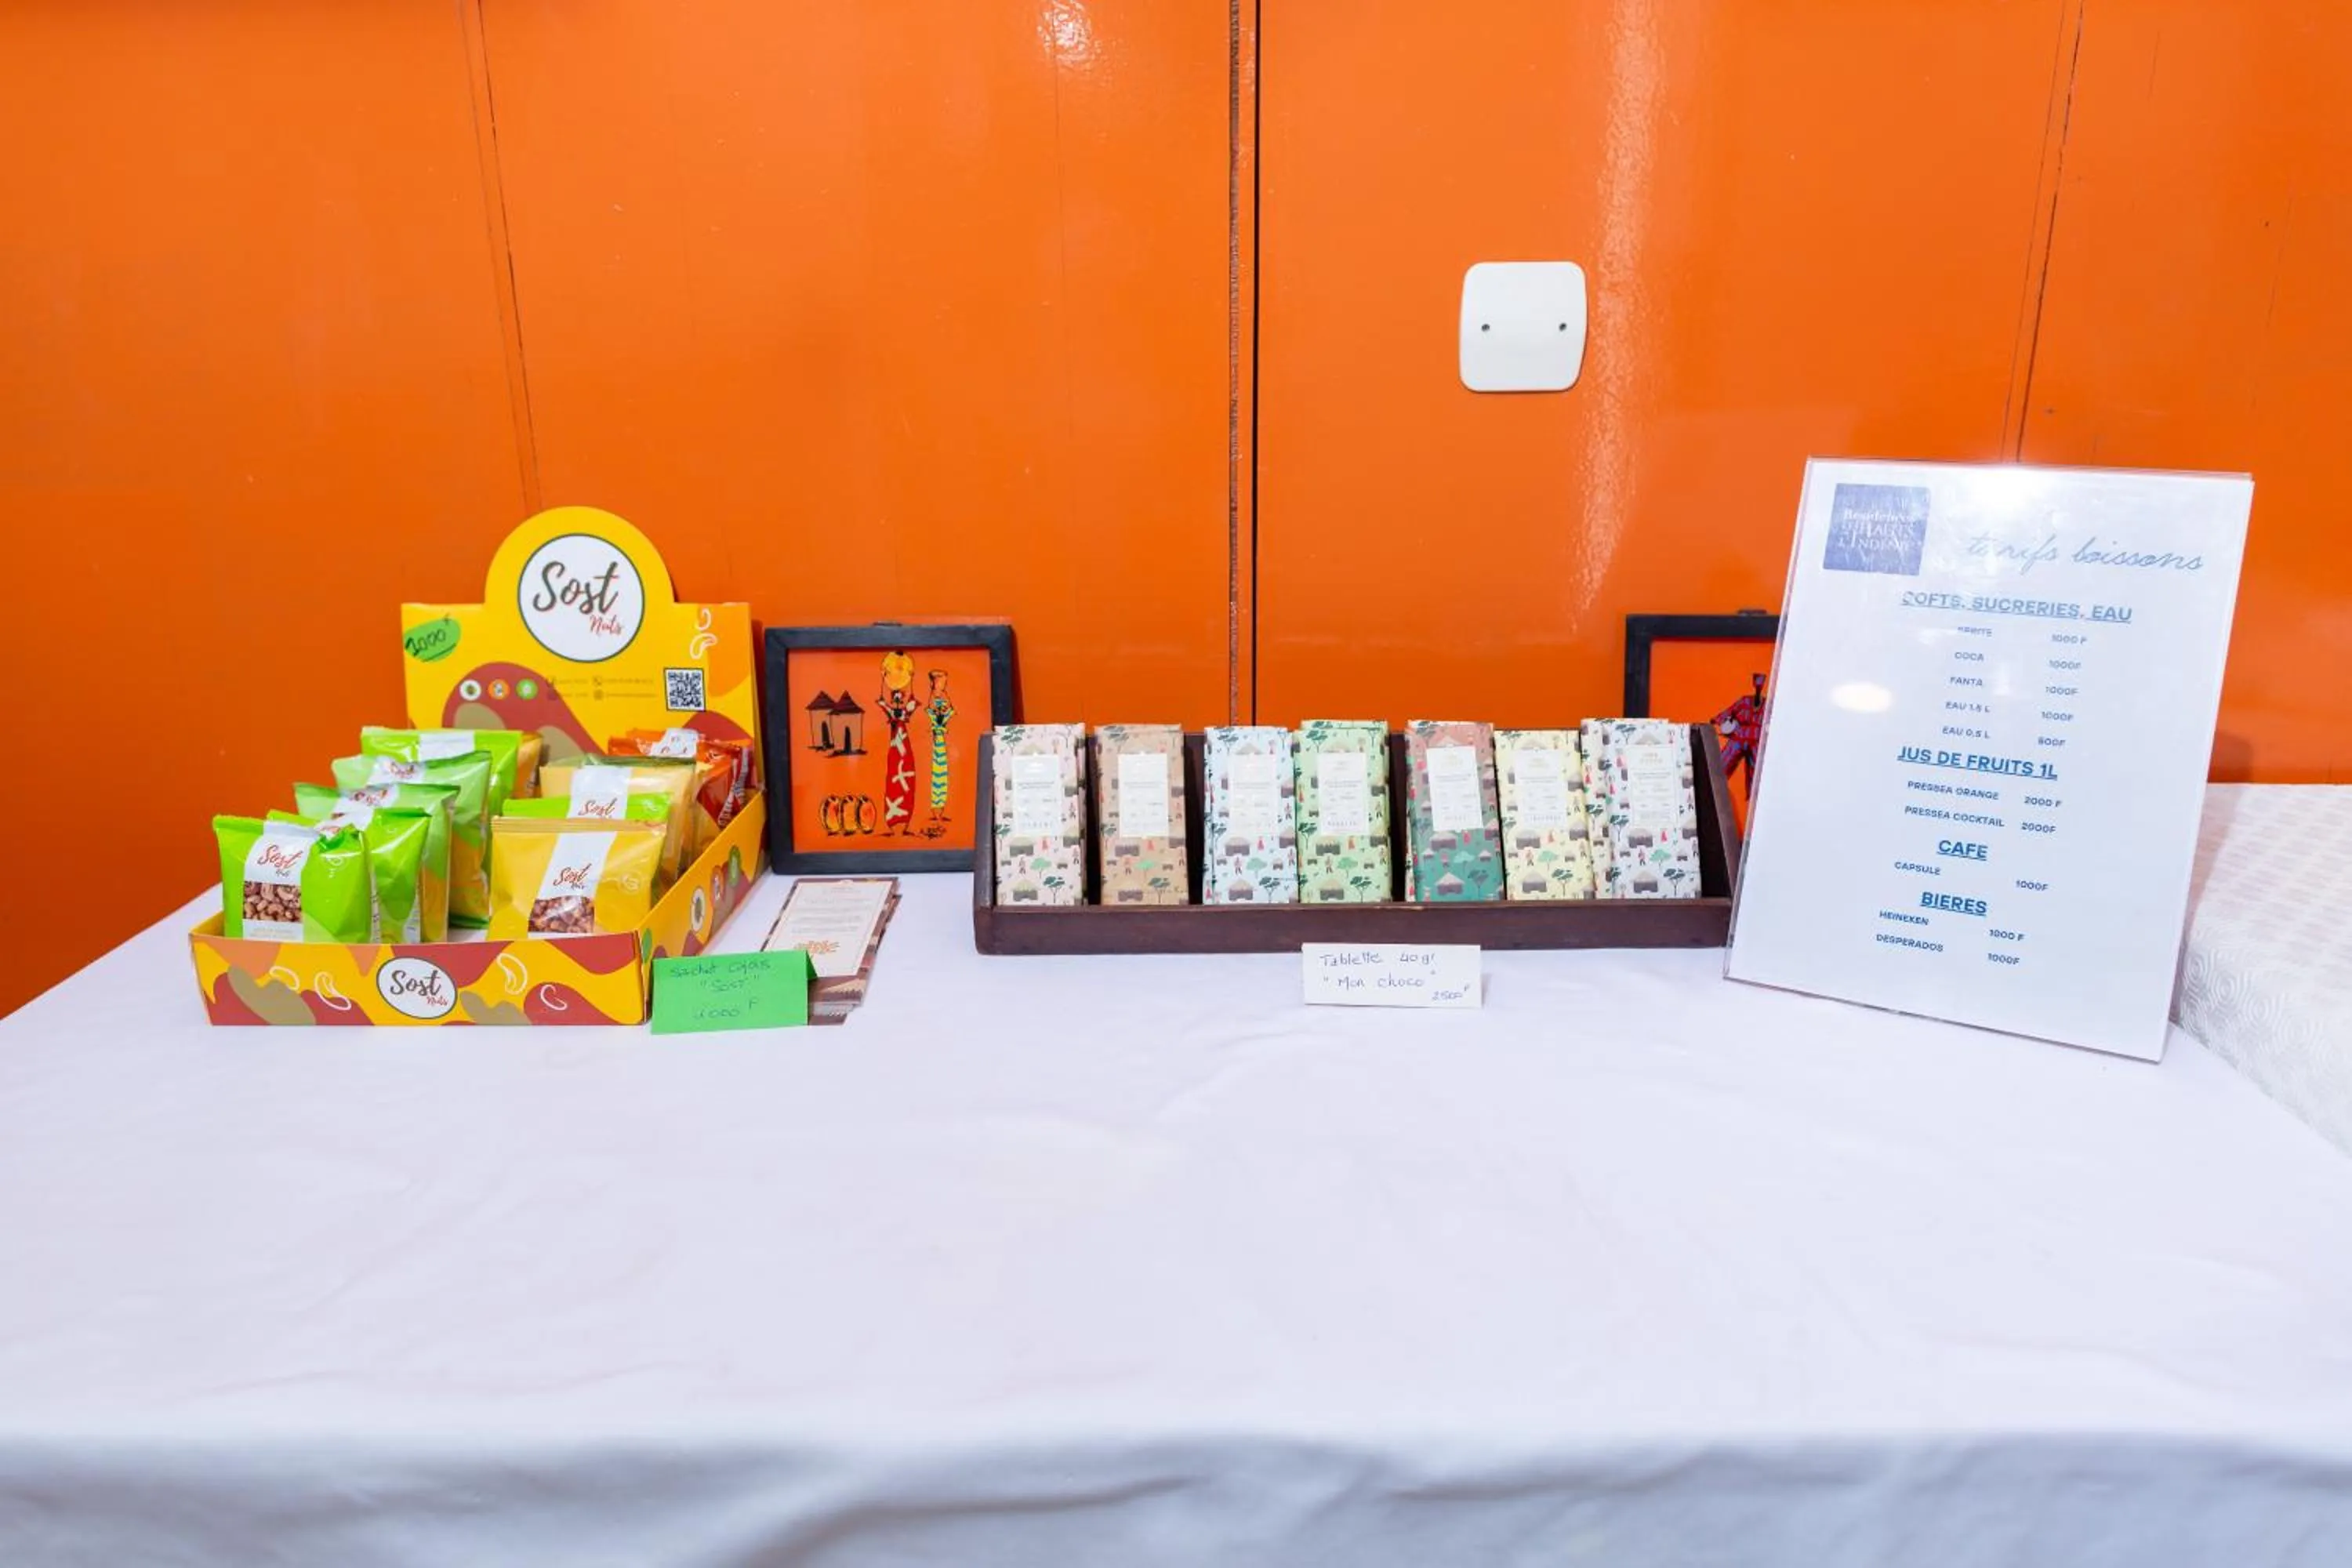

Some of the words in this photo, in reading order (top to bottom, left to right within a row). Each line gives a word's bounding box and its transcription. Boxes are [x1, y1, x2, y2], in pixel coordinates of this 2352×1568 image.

[2071, 536, 2204, 570] boissons
[532, 561, 619, 614] Sost
[2092, 605, 2132, 622] EAU
[590, 615, 622, 636] Nuts
[1955, 652, 1984, 662] COCA
[1950, 677, 1984, 687] FANTA
[1945, 701, 1967, 711] EAU
[2042, 711, 2074, 721] 1000F
[1942, 726, 1963, 735] EAU
[1965, 728, 1982, 738] 0.5
[1984, 730, 1991, 739] L
[1898, 746, 1933, 762] JUS
[1937, 750, 1962, 767] DE
[1966, 755, 2034, 776] FRUITS
[2039, 763, 2058, 780] 1L
[1955, 787, 1999, 800] ORANGE
[2024, 797, 2052, 808] 2000
[1953, 812, 2005, 827] COCKTAIL
[2021, 822, 2057, 833] 2000F
[257, 844, 303, 869] Sost
[1938, 840, 1988, 859] CAFE
[553, 863, 592, 886] Sost
[1894, 861, 1941, 876] CAPSULE
[2016, 880, 2049, 891] 1000F
[1921, 891, 1988, 915] BIERES
[1879, 910, 1929, 926] HEINEKEN
[1989, 929, 2015, 940] 1000
[1876, 934, 1944, 952] DESPERADOS
[1987, 953, 2020, 965] 1000F
[390, 969, 441, 996] Sost
